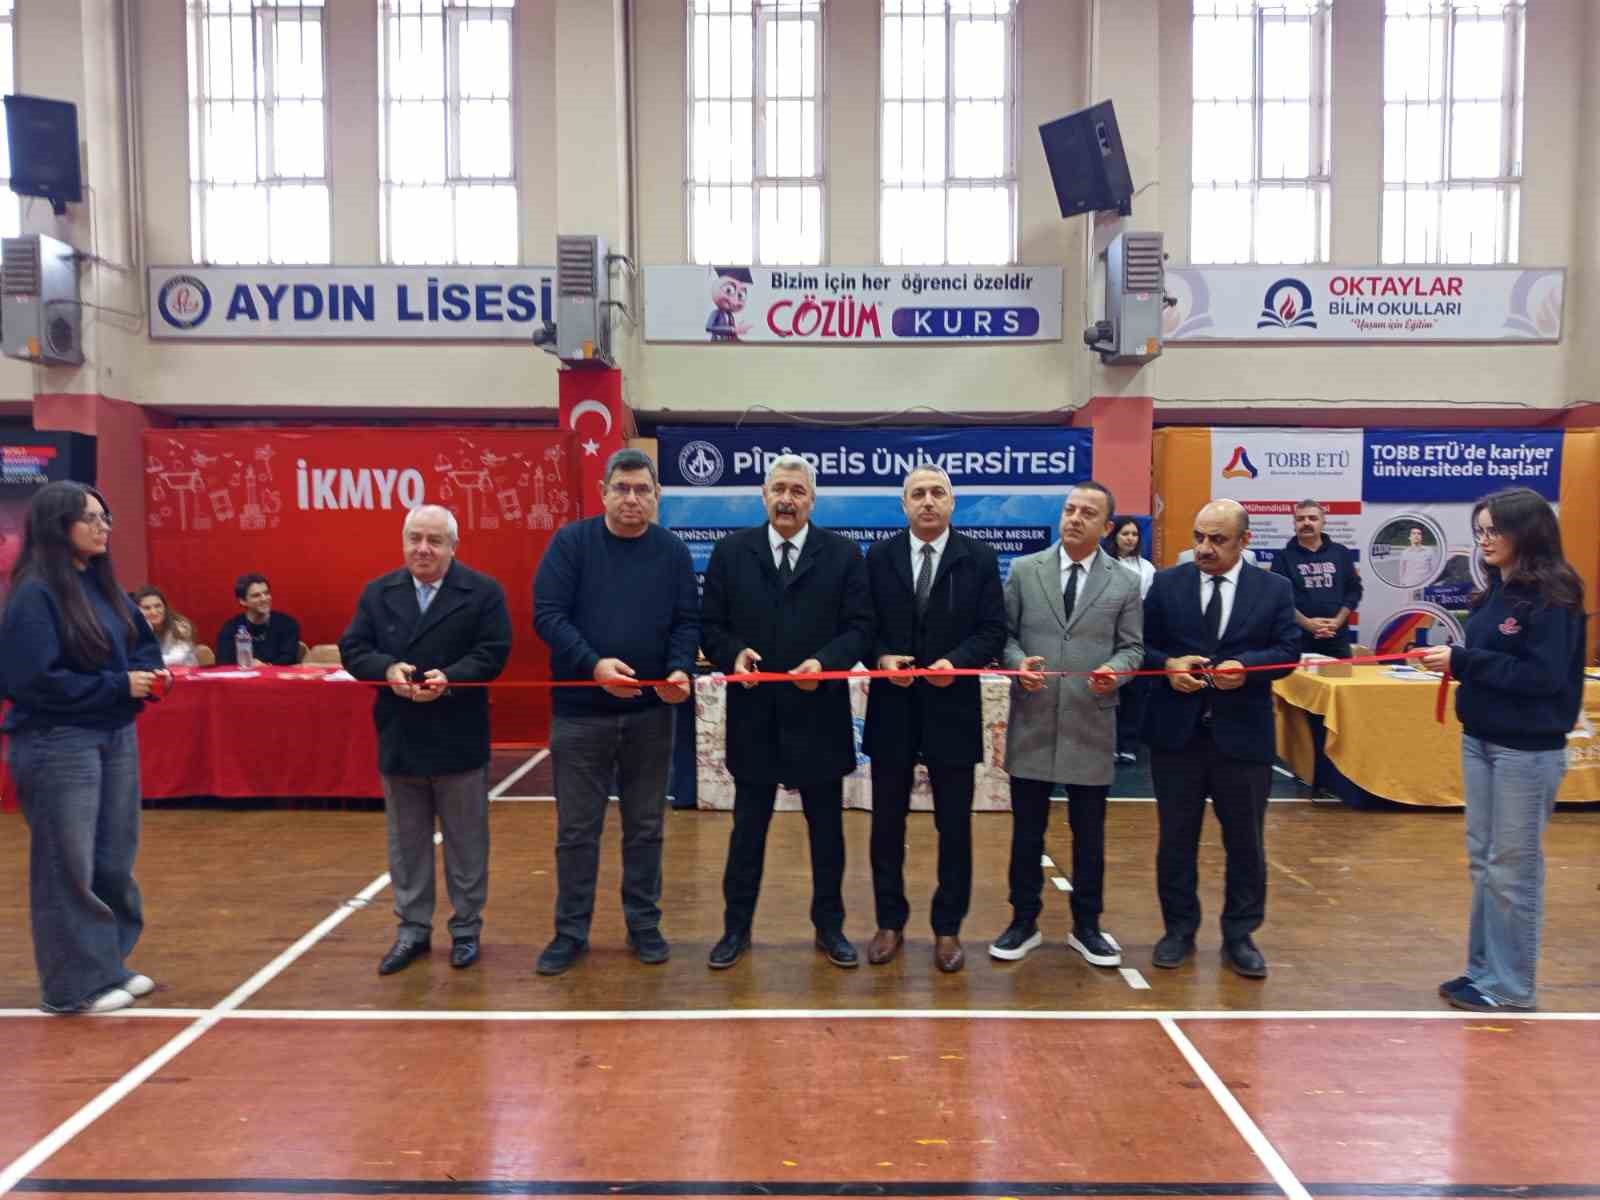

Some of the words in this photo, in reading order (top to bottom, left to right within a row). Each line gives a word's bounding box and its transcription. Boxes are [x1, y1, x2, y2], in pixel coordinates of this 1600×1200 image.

[771, 271, 819, 290] Bizim
[825, 271, 857, 294] için
[862, 272, 891, 291] her
[901, 273, 968, 294] öğrenci
[973, 272, 1034, 291] özeldir
[1328, 275, 1464, 297] OKTAYLAR
[226, 283, 376, 322] AYDIN
[396, 276, 552, 322] LİSESİ
[1328, 297, 1374, 316] BİLİM
[1376, 301, 1462, 316] OKULLARI
[914, 309, 1021, 335] KURS
[1264, 452, 1311, 468] TOBB
[1316, 449, 1350, 468] ETÜ
[1371, 444, 1420, 461] TOBB
[1490, 443, 1553, 463] kariyer
[1373, 461, 1484, 477] üniversitede
[1487, 461, 1549, 480] başlar!
[296, 457, 425, 511] İKMYO
